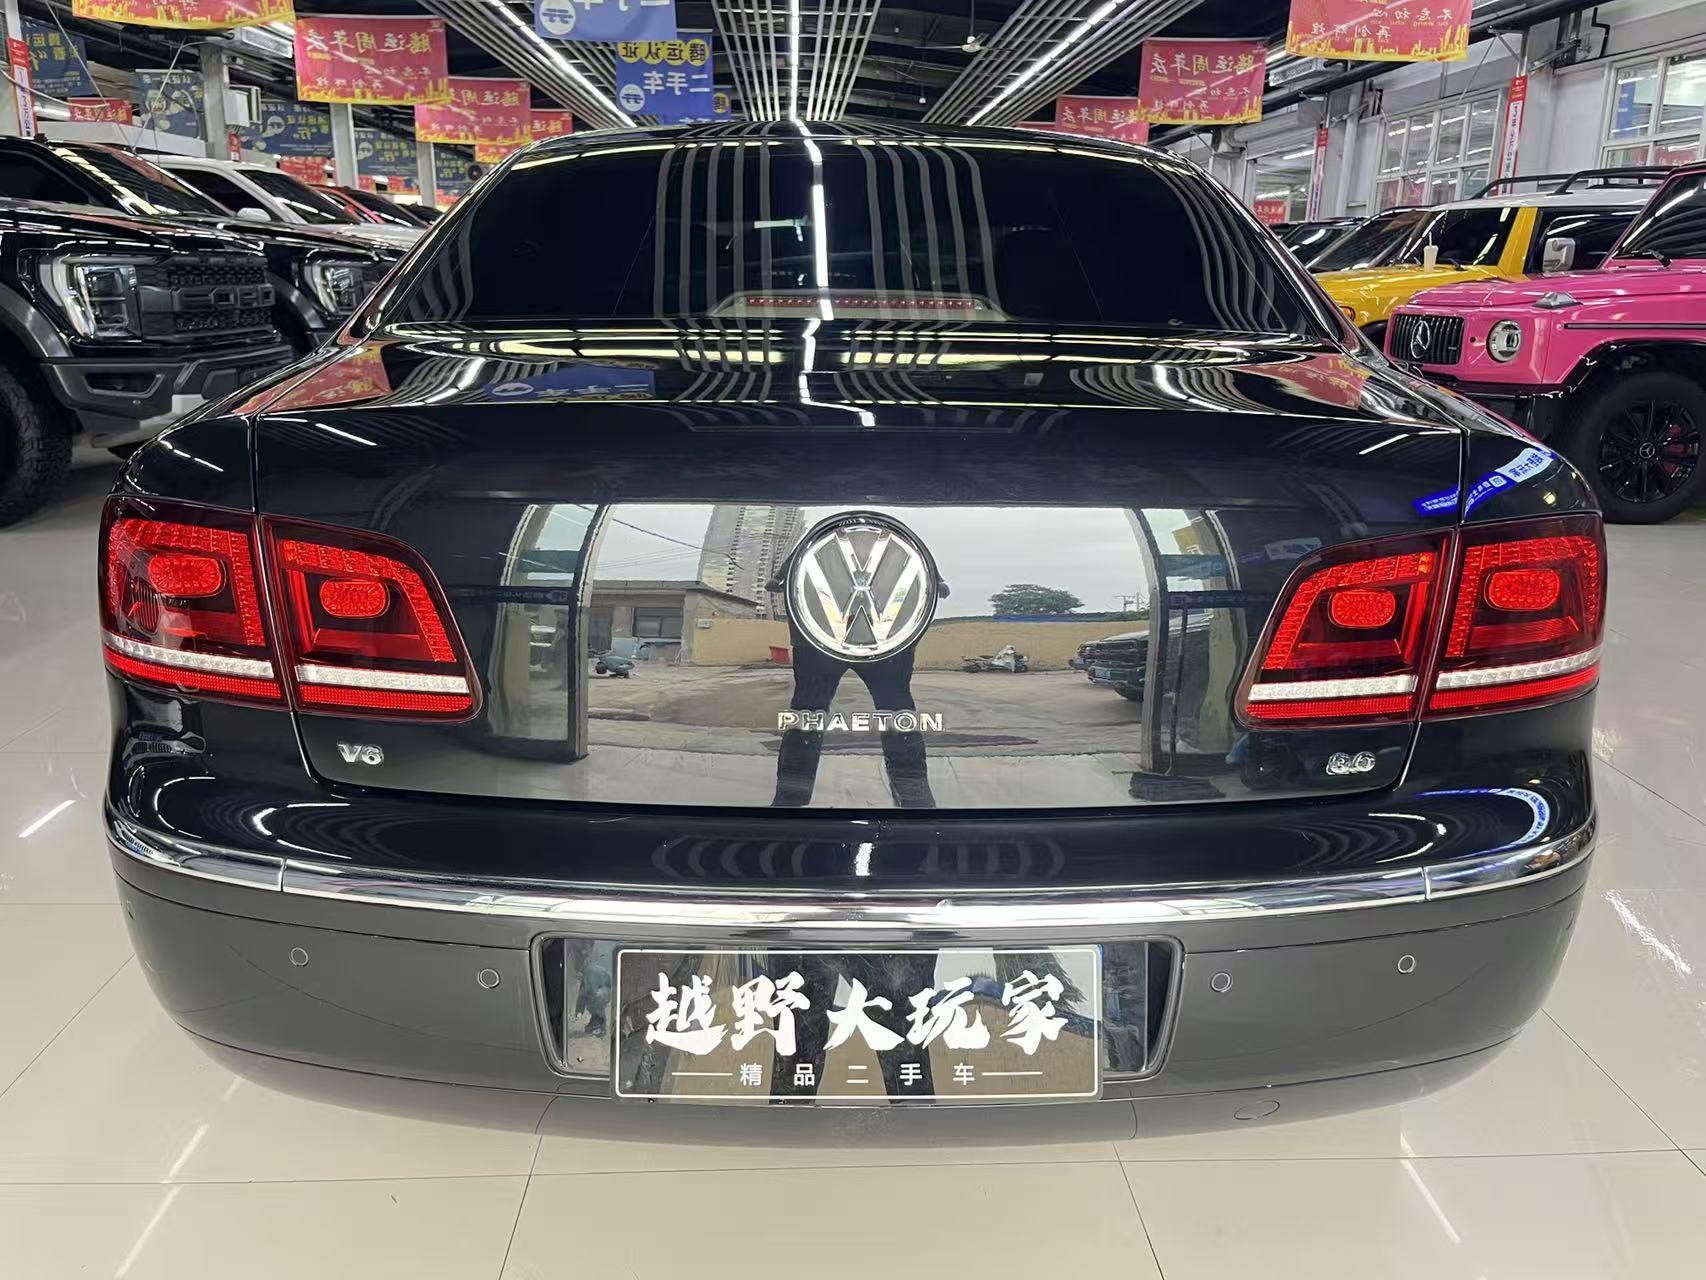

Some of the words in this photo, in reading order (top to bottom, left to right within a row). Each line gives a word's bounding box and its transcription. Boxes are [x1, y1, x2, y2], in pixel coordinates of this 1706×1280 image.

[777, 710, 943, 732] PHAETON
[337, 743, 384, 765] V6
[645, 969, 1070, 1057] 越野大玩家
[740, 1063, 976, 1087] 精品二手车
